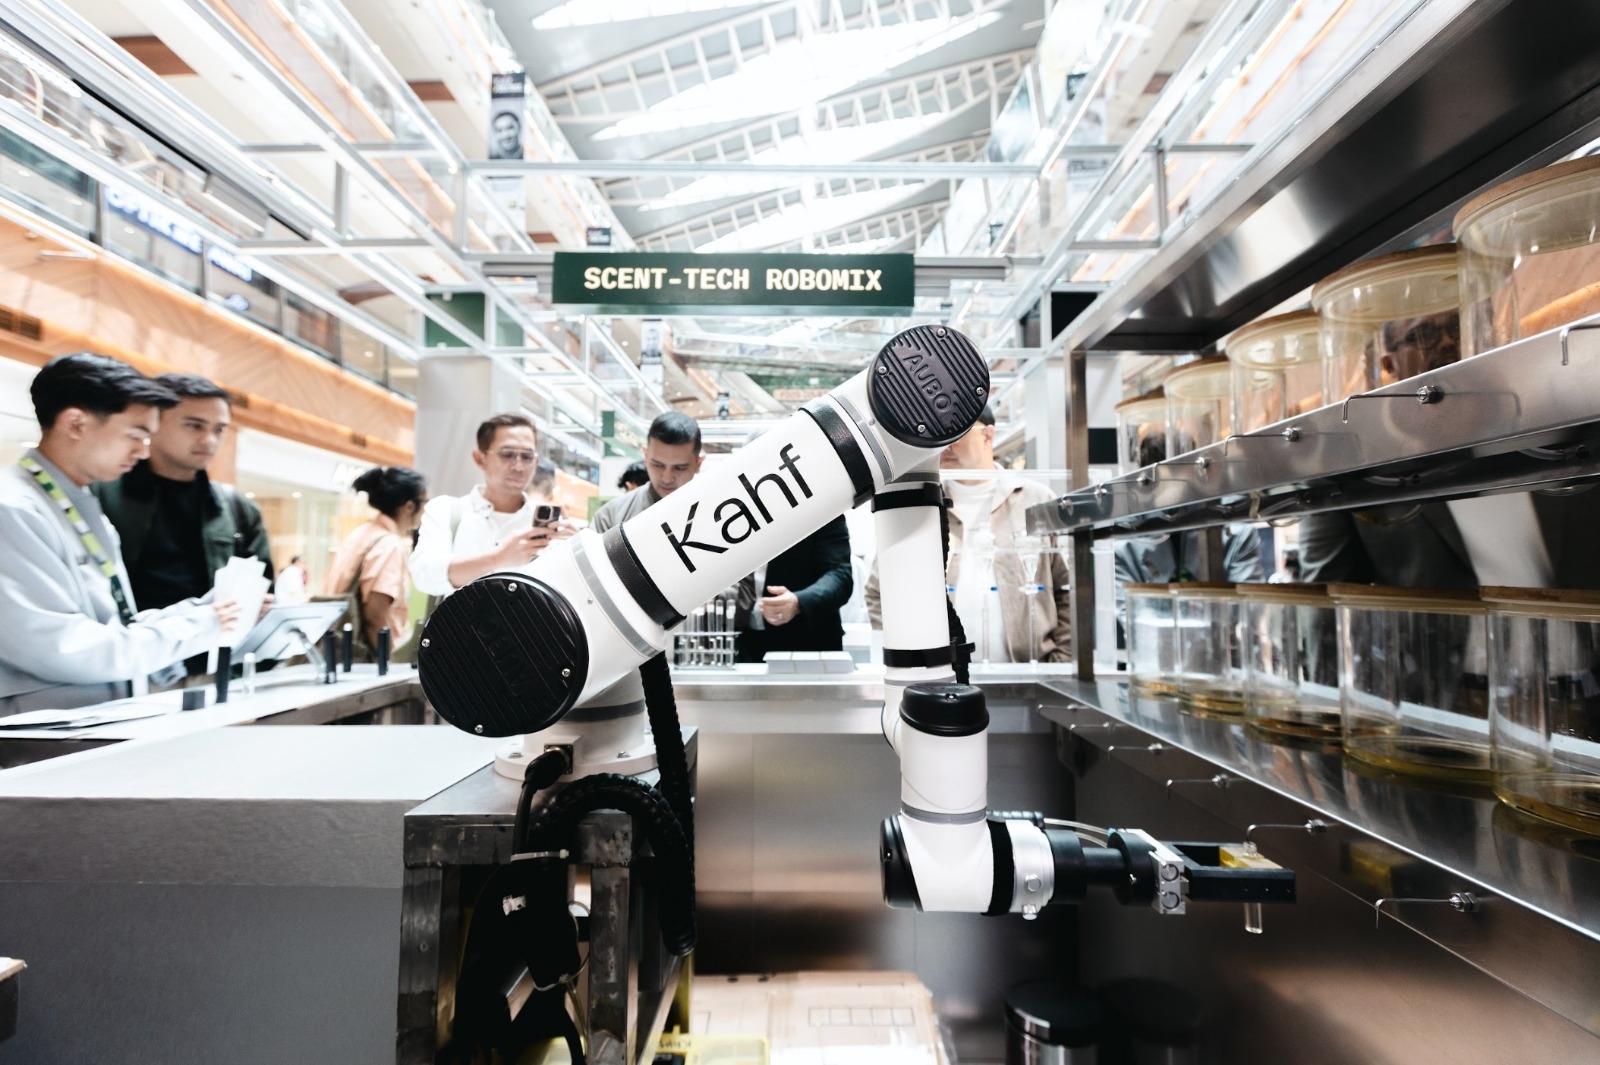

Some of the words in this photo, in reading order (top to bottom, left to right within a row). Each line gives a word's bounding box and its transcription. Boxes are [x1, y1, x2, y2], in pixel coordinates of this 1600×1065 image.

[583, 266, 750, 291] SCENT-TECH
[766, 268, 882, 292] ROBOMIX
[903, 354, 952, 413] AUBO
[660, 442, 814, 574] Kahf
